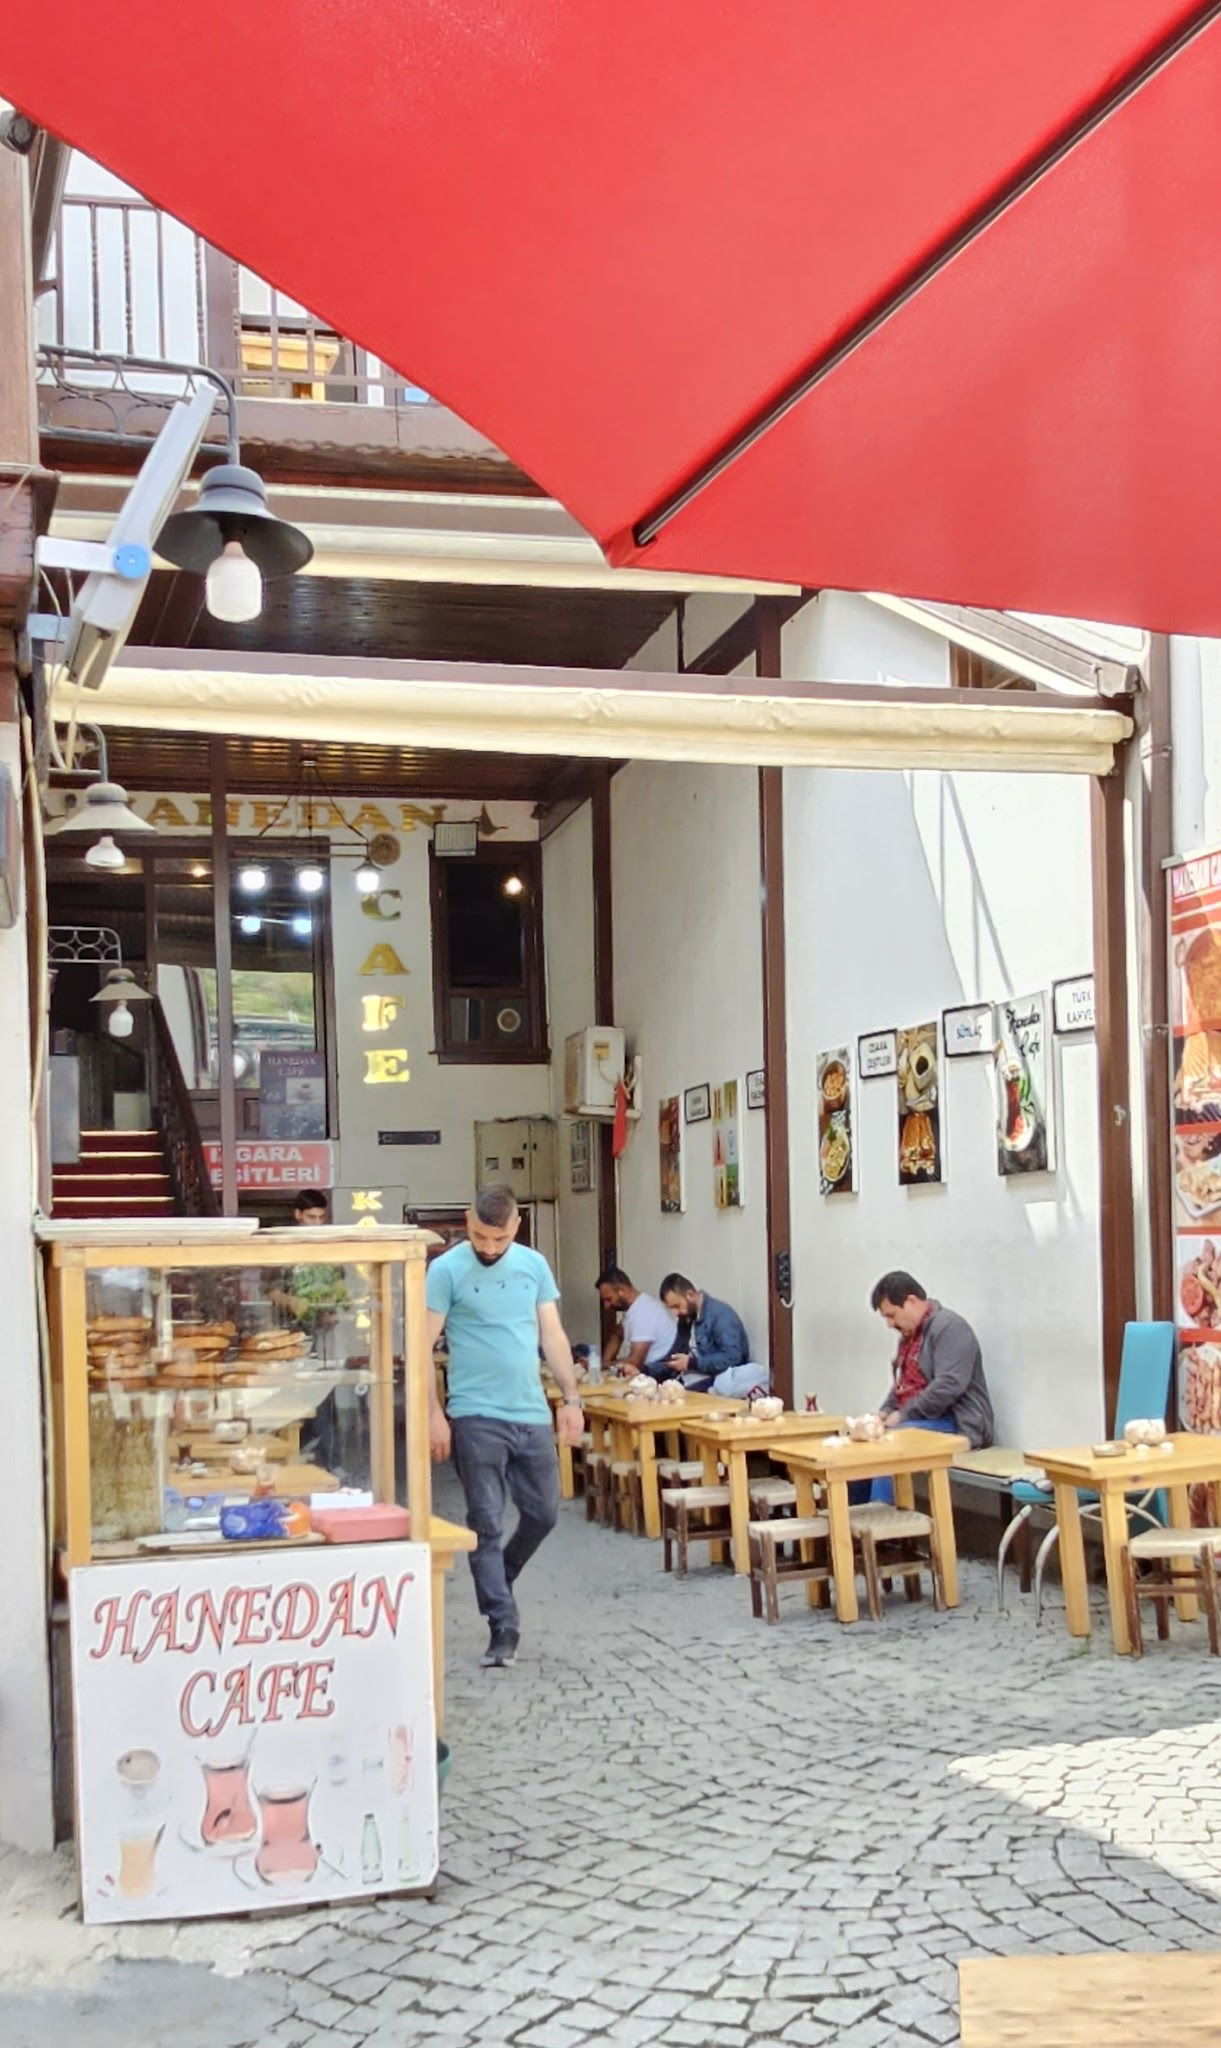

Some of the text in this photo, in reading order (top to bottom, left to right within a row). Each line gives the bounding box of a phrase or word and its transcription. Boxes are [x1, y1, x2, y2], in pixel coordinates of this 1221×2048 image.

[128, 797, 448, 833] ANEDAN
[91, 1572, 415, 1664] HANEDAN
[179, 1656, 336, 1738] CAFE
